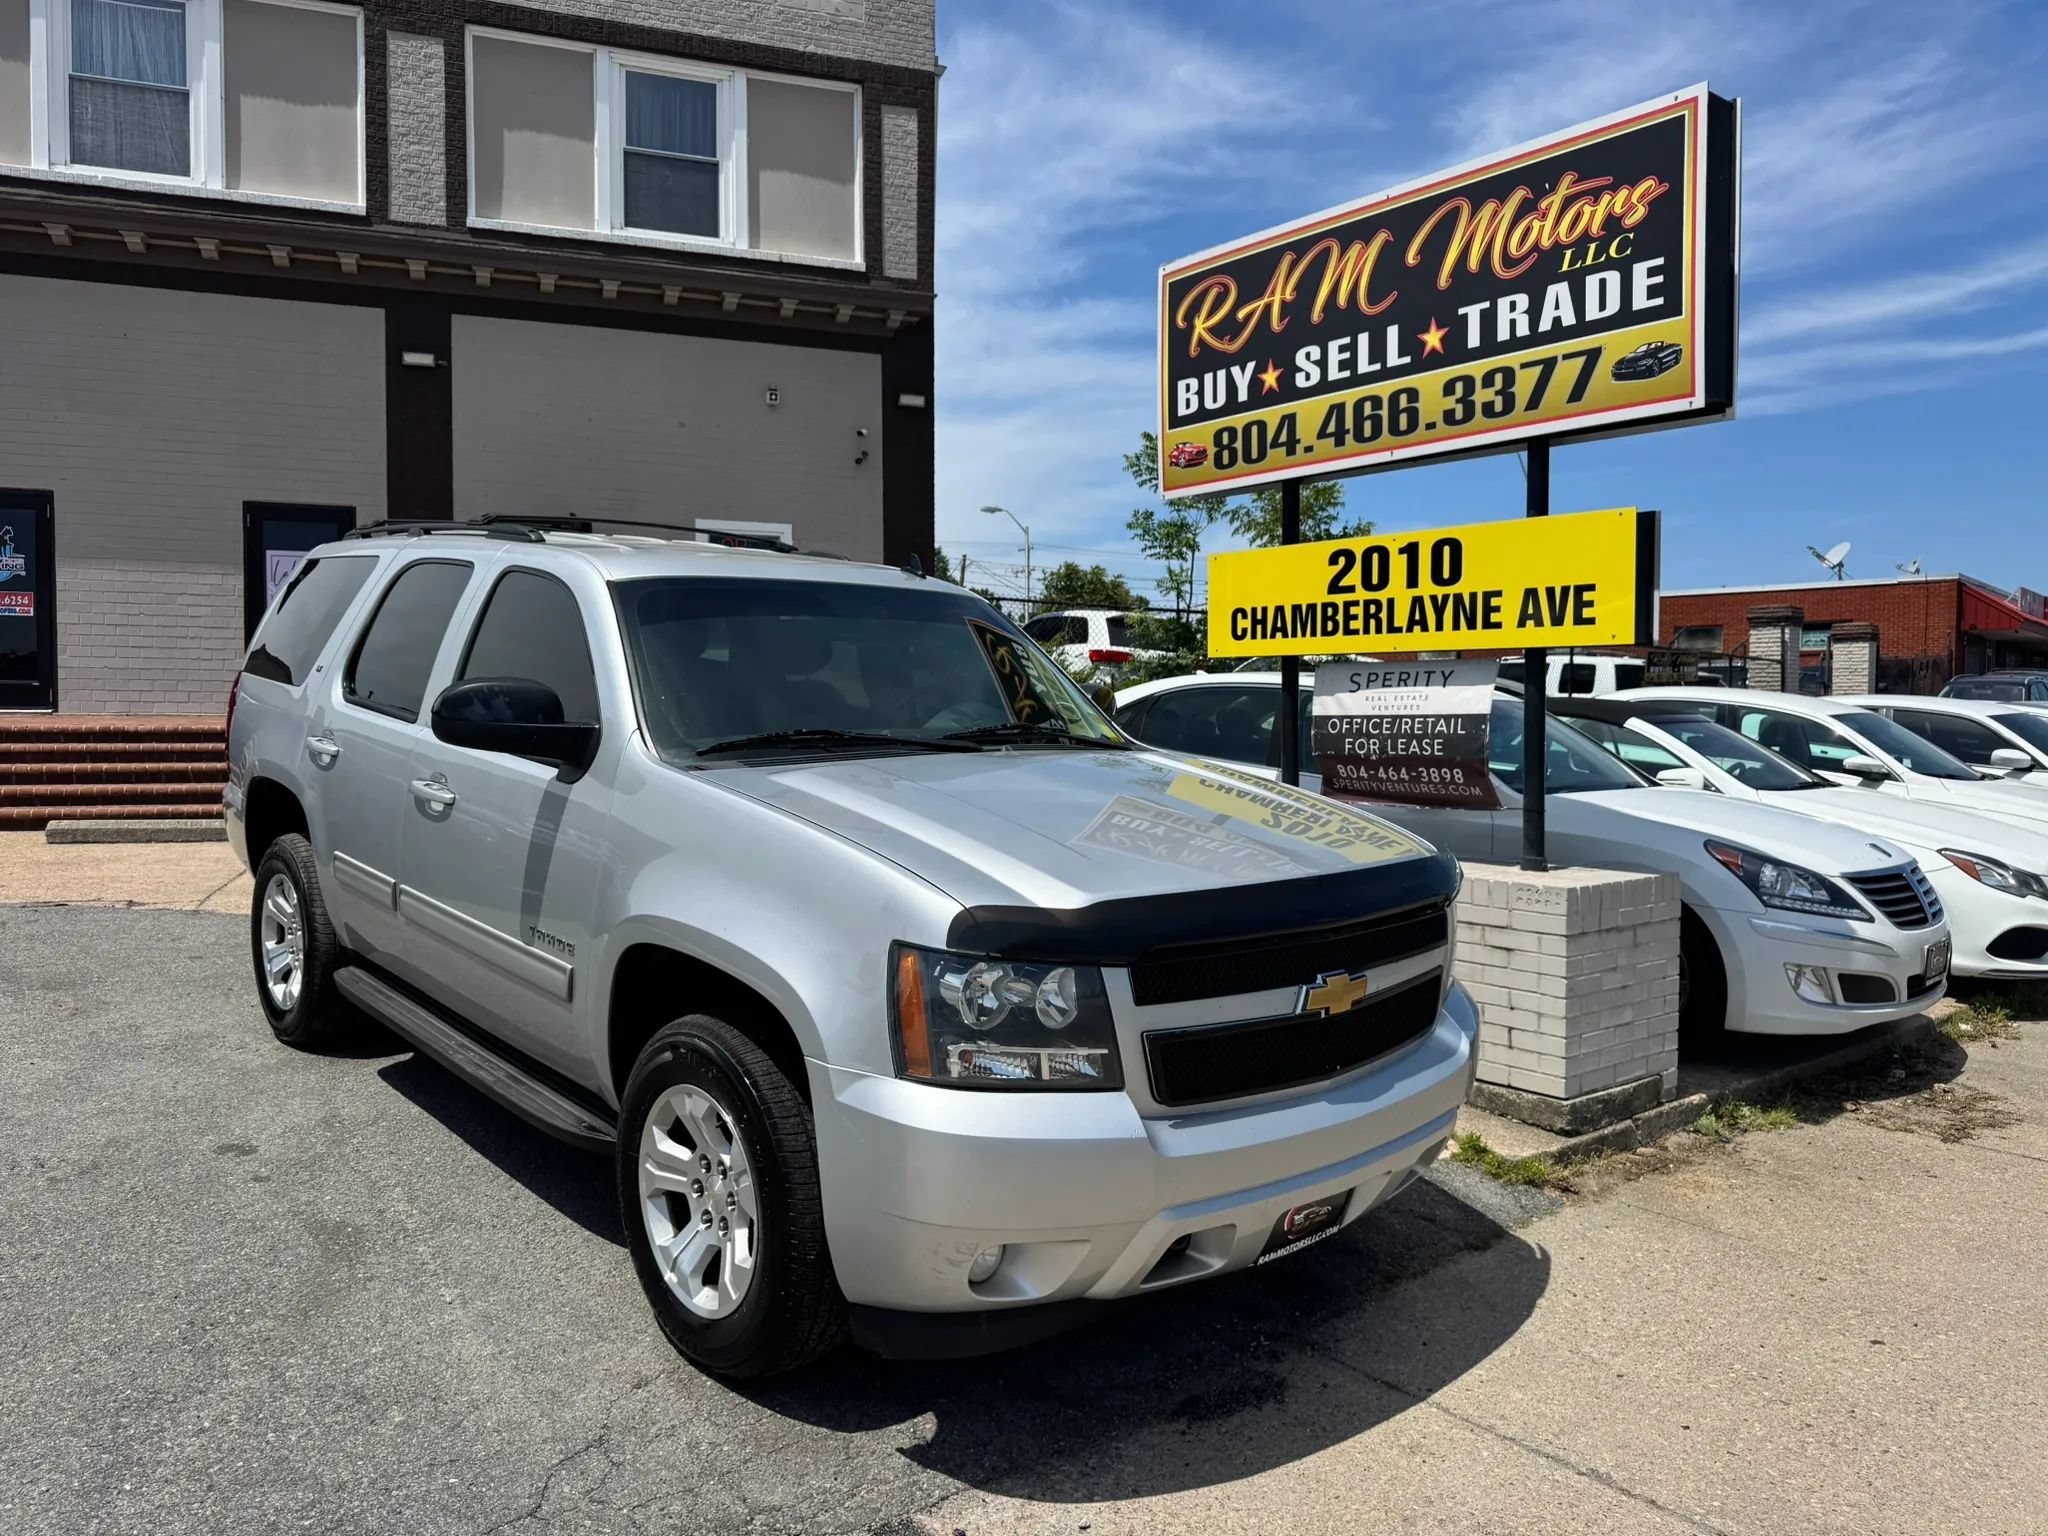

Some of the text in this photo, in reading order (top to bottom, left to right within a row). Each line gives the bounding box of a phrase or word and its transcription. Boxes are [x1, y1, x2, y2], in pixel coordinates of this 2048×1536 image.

[1557, 232, 1635, 273] LLC
[1176, 170, 1670, 359] RAM Motors
[1176, 256, 1665, 418] BUY SELL TRADE
[1212, 345, 1603, 471] 804.466.3377
[1326, 536, 1463, 596] 2010
[0, 595, 29, 605] .6254
[1230, 583, 1597, 642] CHAMBERLAYNE AVE
[1348, 669, 1456, 694] SPERITY
[1371, 704, 1422, 712] VENTURES
[1394, 694, 1430, 702] ESTATE
[1327, 717, 1467, 735] OFFICE/RETAIL
[1344, 738, 1445, 756] FOR LEASE
[1336, 764, 1465, 784] 804-464-3898
[1332, 778, 1484, 797] SPERITYVENTURES.COM
